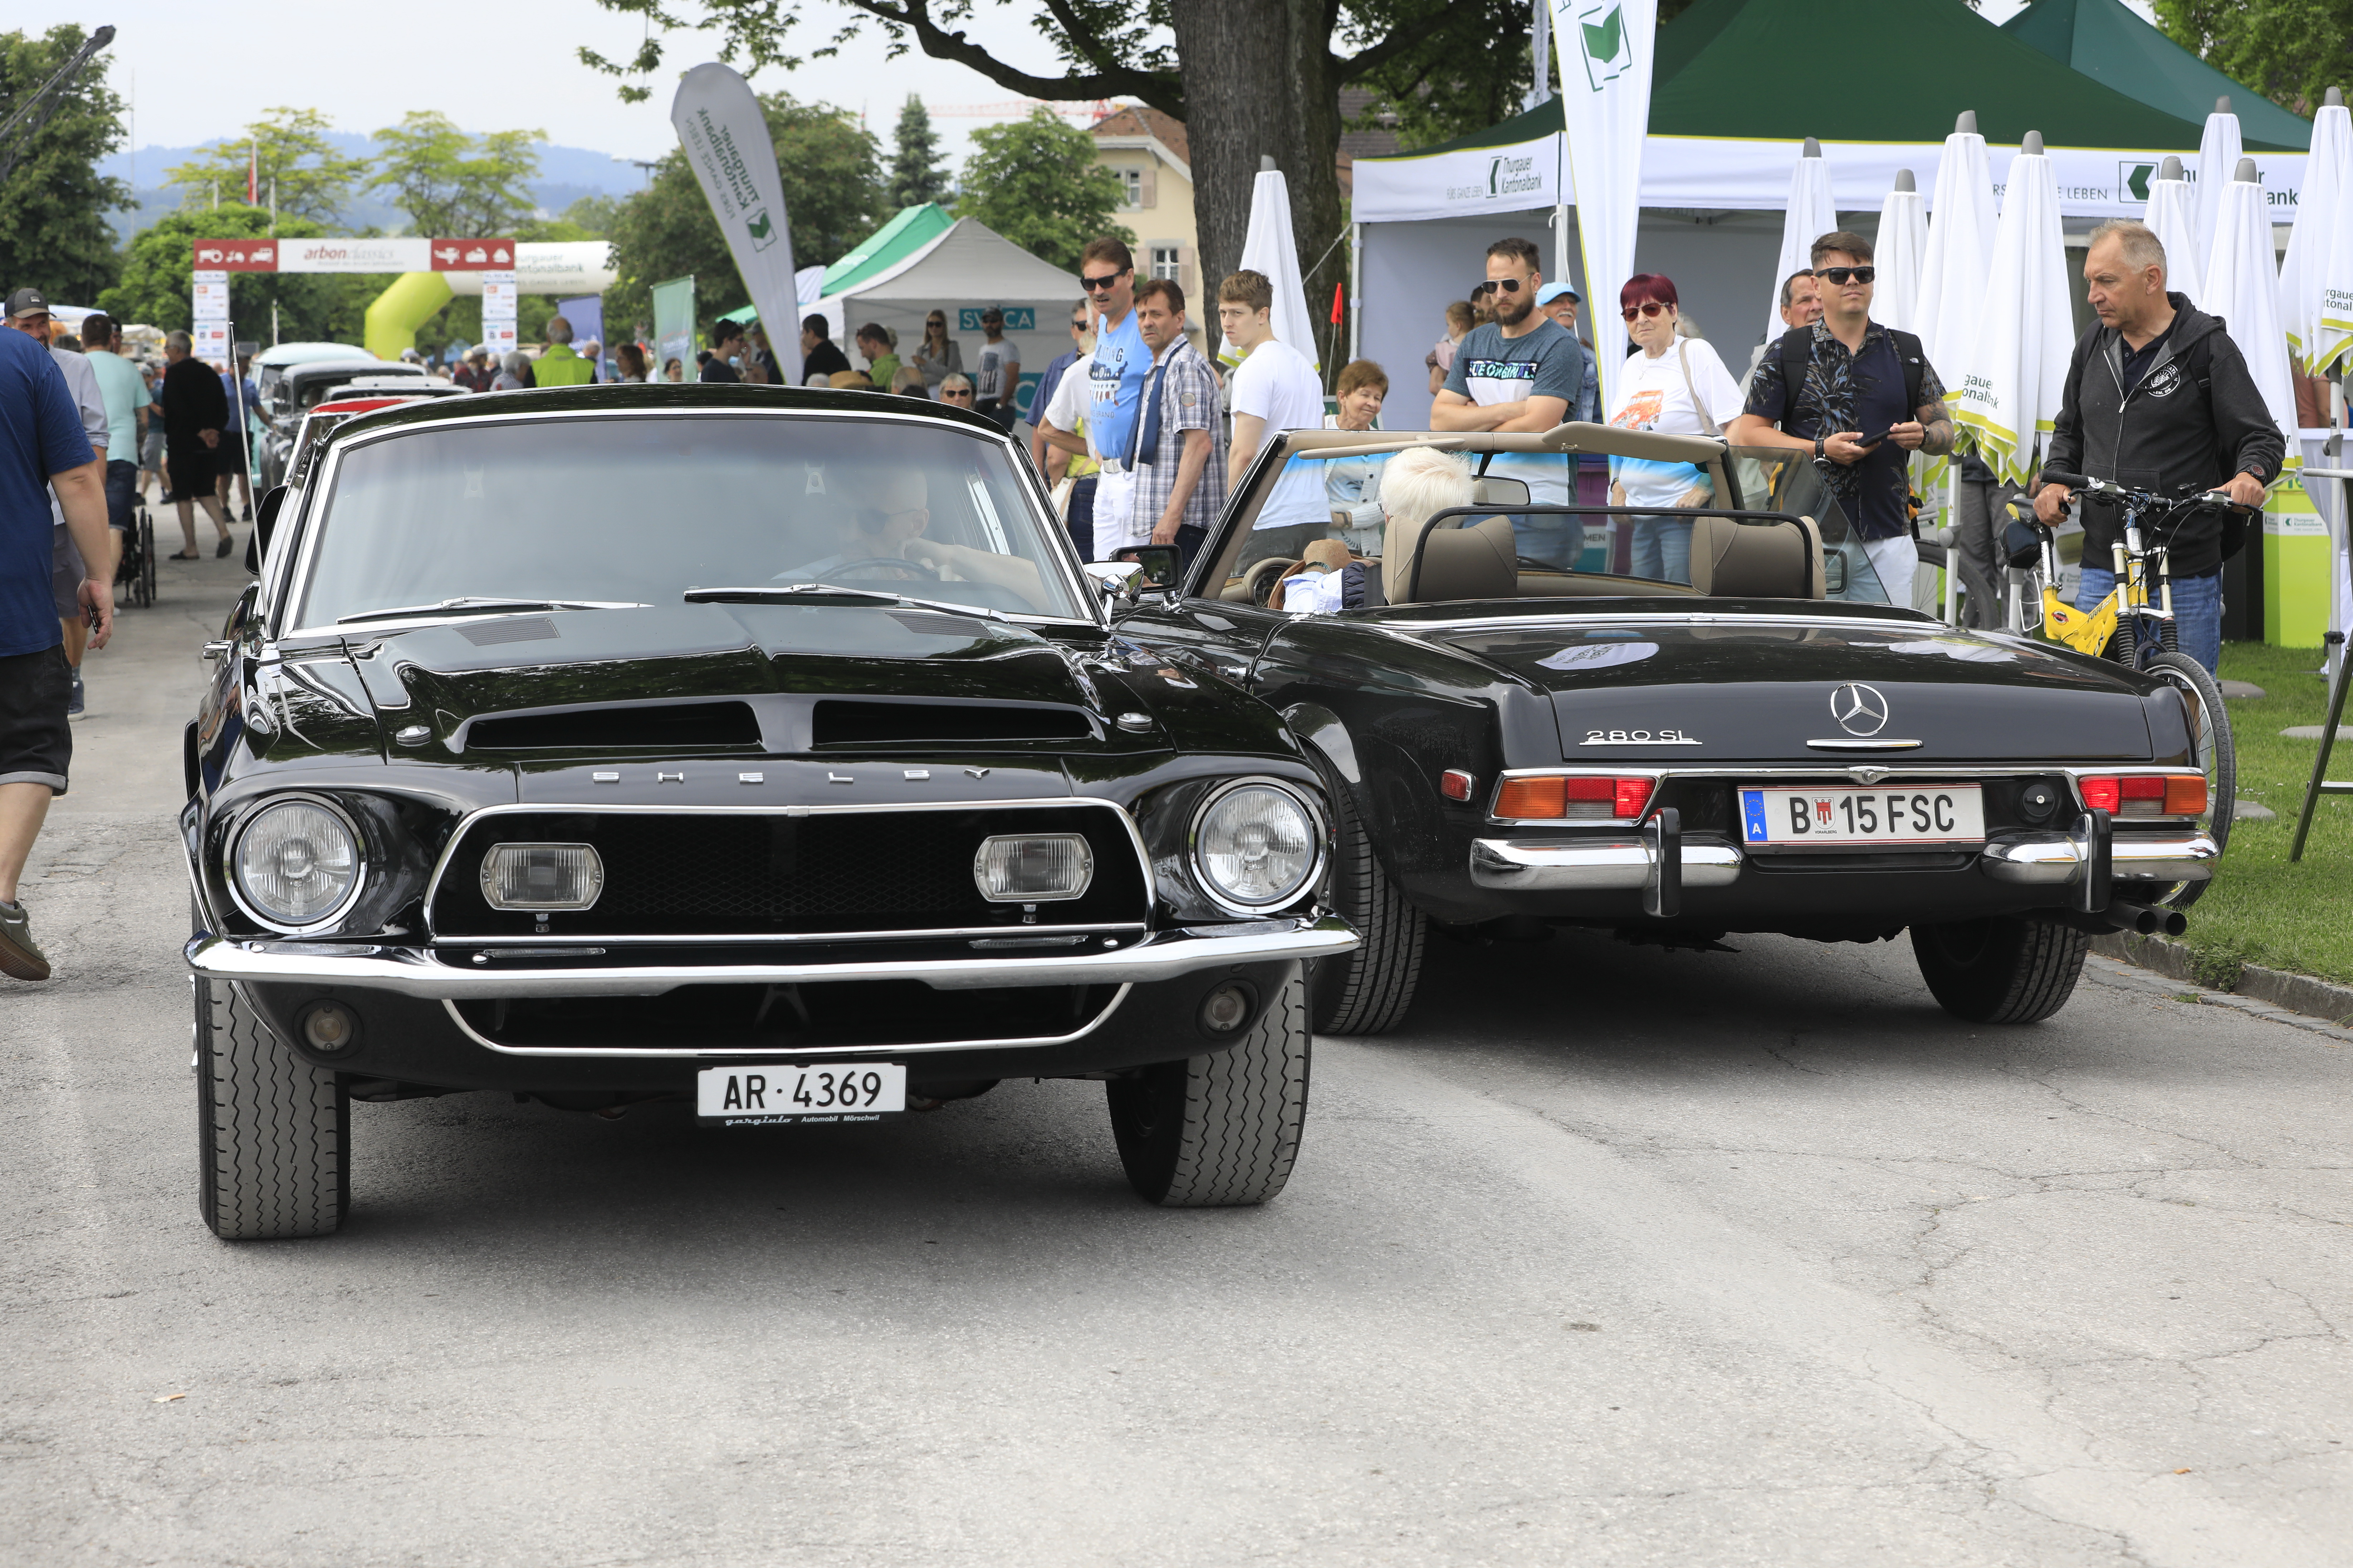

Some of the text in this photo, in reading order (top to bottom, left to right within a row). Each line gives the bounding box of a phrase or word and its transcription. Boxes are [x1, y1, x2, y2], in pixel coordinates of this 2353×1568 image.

[1503, 157, 1532, 176] Thurgauer
[1501, 172, 1542, 194] Kantonalbank
[2067, 187, 2108, 200] LEBEN
[1586, 730, 1694, 741] 280 SL
[592, 768, 990, 784] SHELBY
[1790, 797, 1810, 834] B
[1752, 823, 1762, 834] A
[725, 1116, 793, 1126] gargiulo
